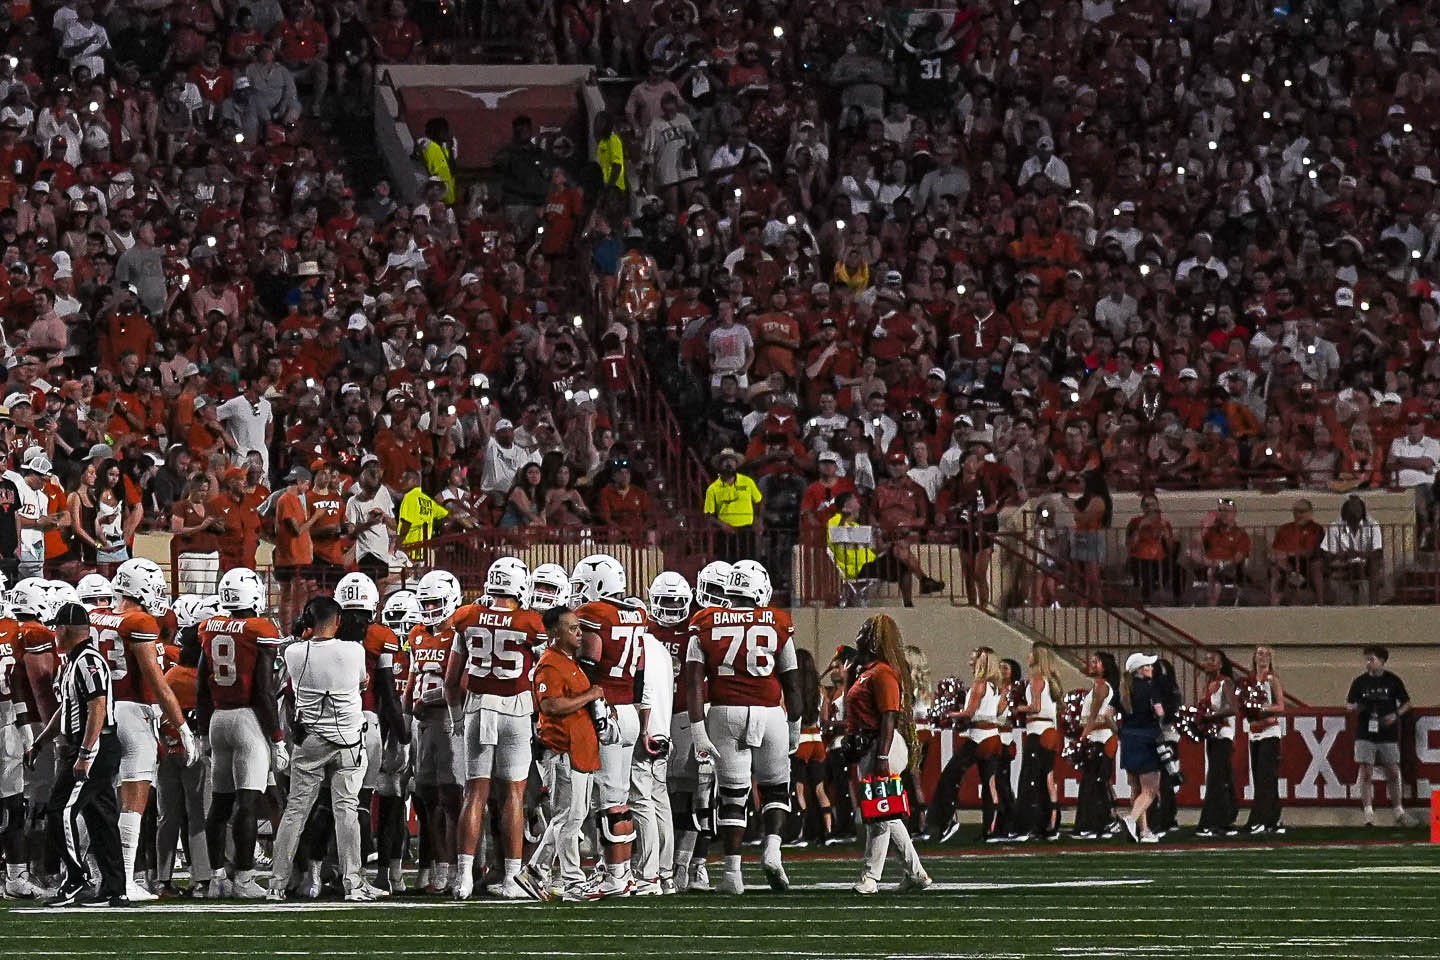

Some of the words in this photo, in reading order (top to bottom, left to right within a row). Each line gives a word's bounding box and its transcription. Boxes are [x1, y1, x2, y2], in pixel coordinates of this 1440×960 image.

[920, 58, 942, 80] 37
[478, 612, 513, 627] HELM
[713, 611, 754, 626] BANKS
[758, 609, 776, 625] JR.
[205, 618, 247, 635] NIBLACK
[211, 634, 236, 687] 8
[415, 648, 445, 662] TEXAS
[464, 627, 528, 679] 85
[712, 626, 778, 678] 78
[877, 800, 890, 813] G
